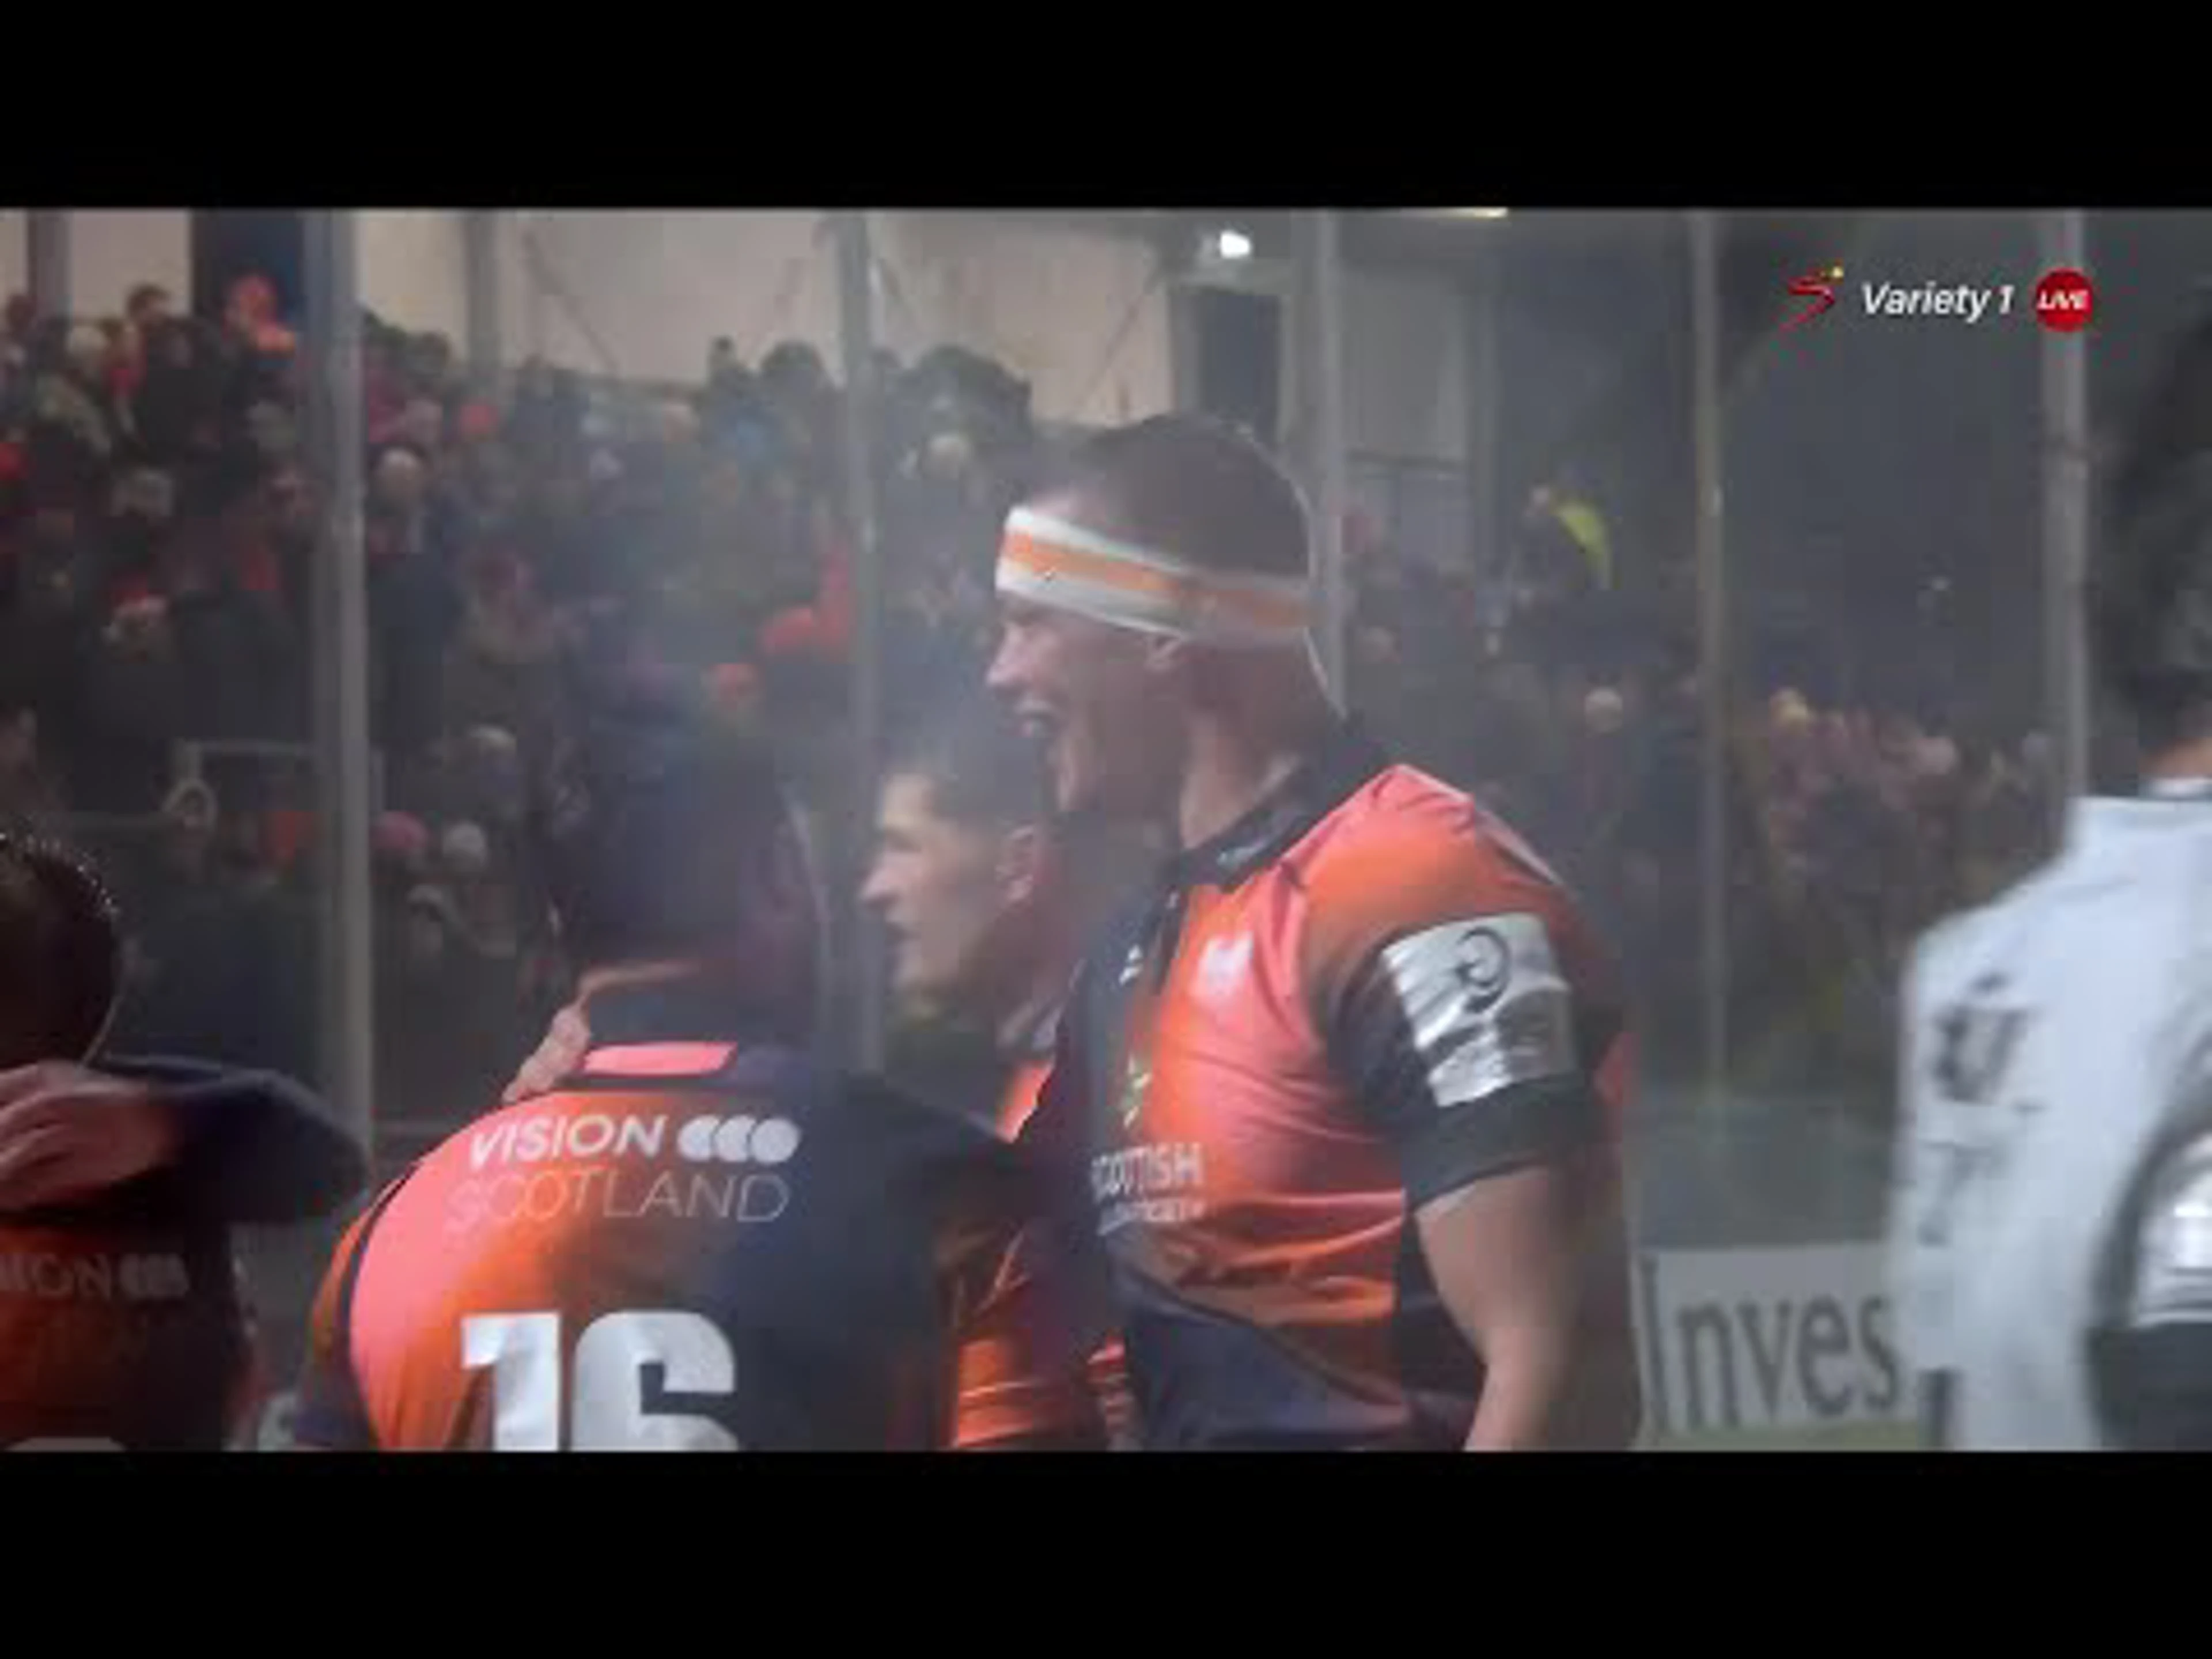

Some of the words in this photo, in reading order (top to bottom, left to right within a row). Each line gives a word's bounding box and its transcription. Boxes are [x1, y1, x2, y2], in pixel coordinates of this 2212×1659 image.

[469, 1114, 669, 1169] VISION
[444, 1166, 790, 1234] SCOTLAND
[461, 1310, 738, 1452] 16
[1639, 1256, 1902, 1435] Inves
